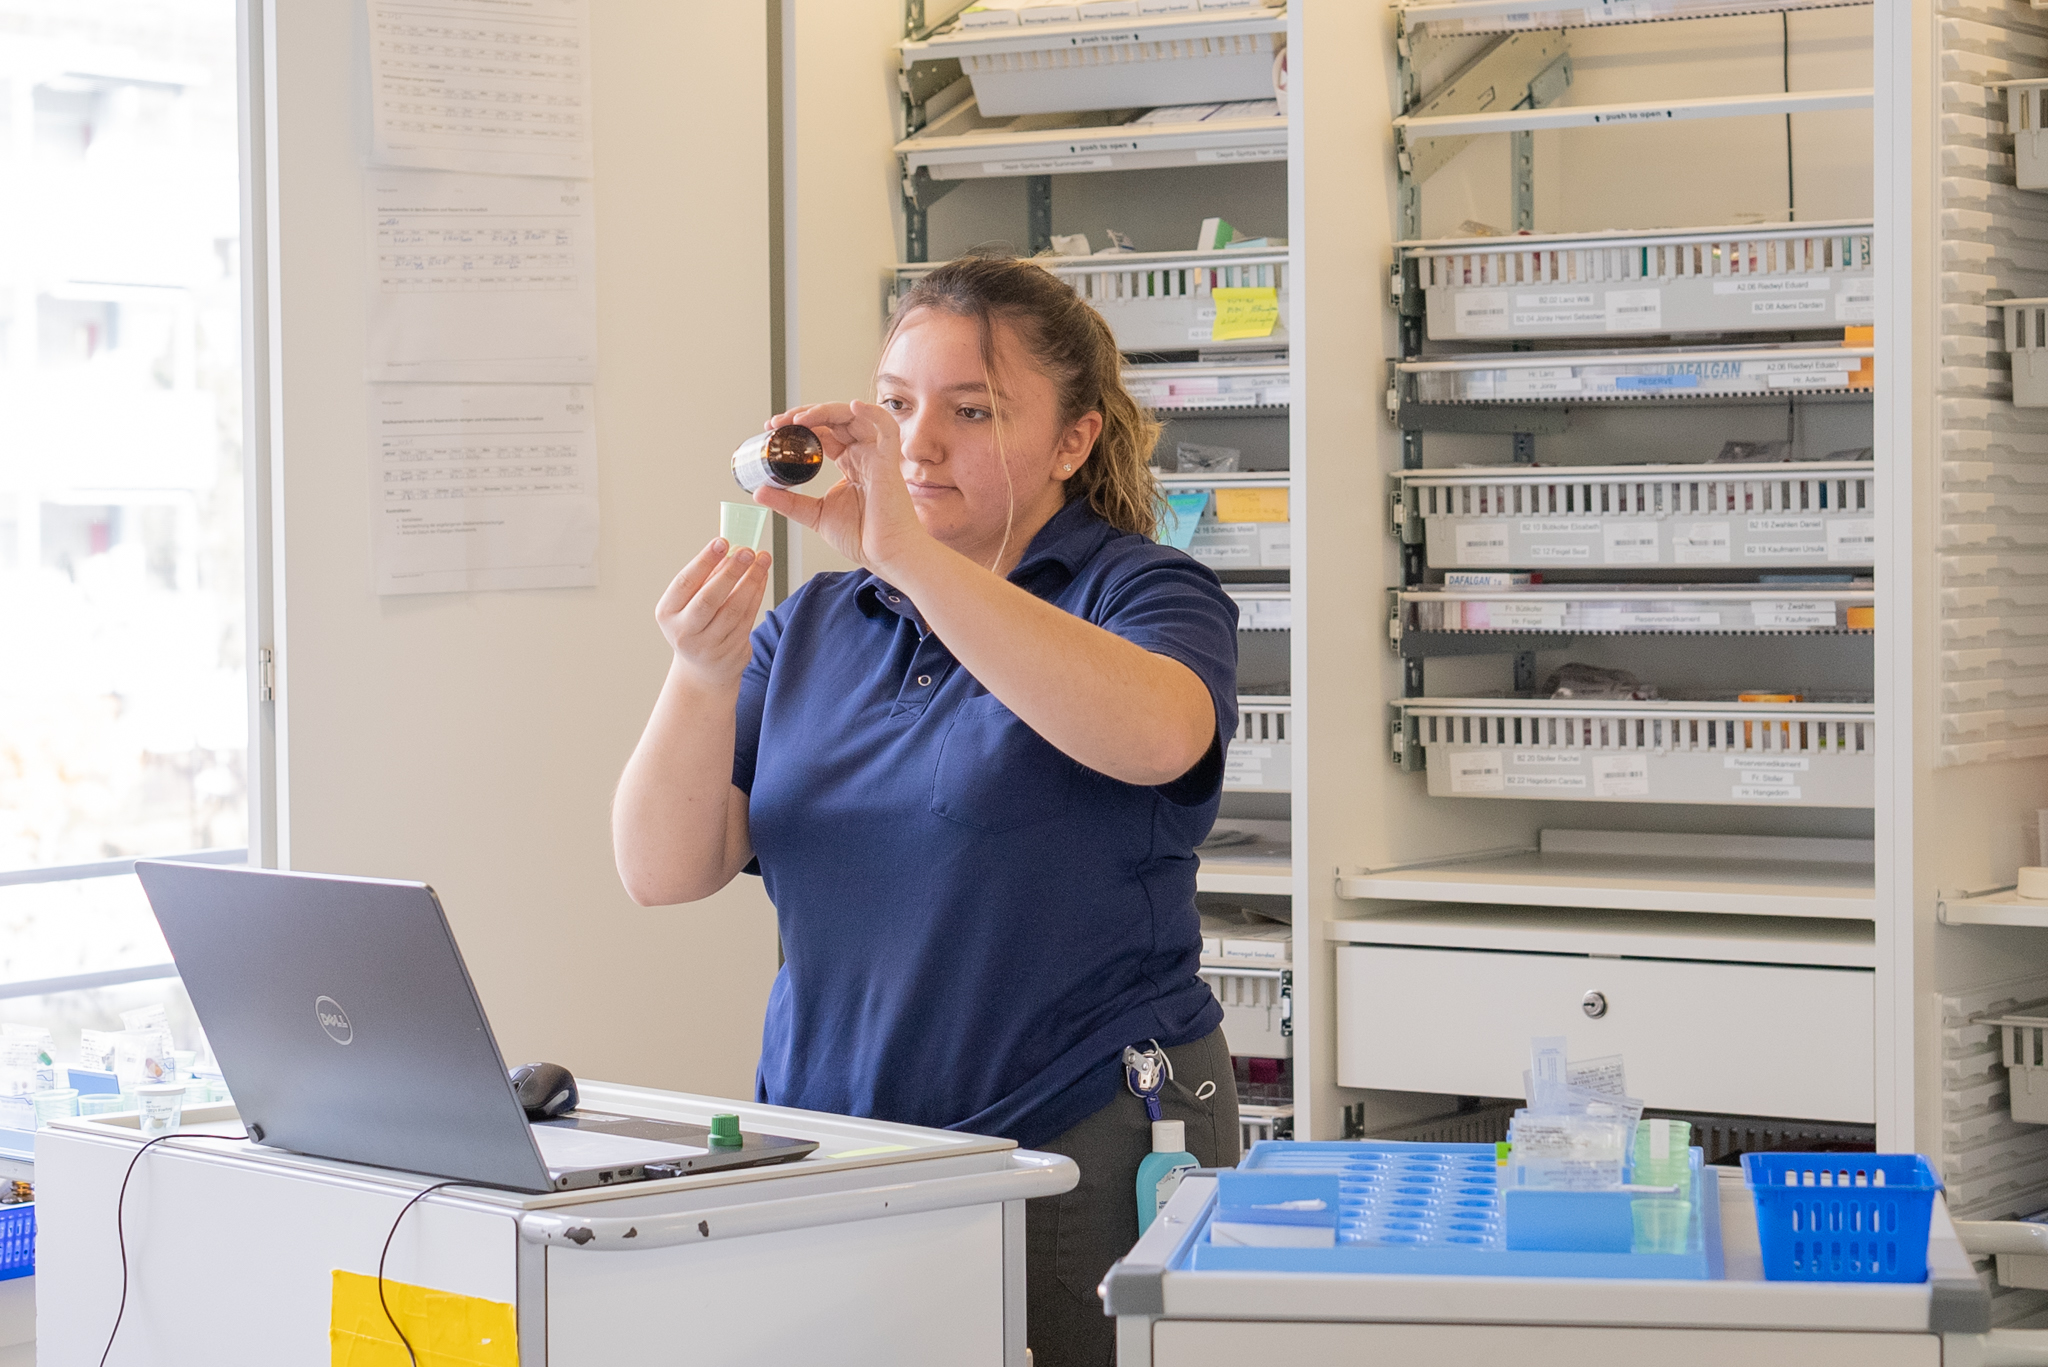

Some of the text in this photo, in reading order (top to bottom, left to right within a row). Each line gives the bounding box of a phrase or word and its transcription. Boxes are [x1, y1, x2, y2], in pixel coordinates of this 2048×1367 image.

[1785, 281, 1809, 289] Eduard
[1815, 361, 1839, 369] Eduard
[1667, 361, 1741, 379] DAFALGAN
[1800, 520, 1821, 528] Daniel
[1449, 576, 1490, 585] DAFALGAN
[1785, 615, 1819, 623] Kaufmann
[1226, 950, 1253, 958] Macrogol
[320, 1012, 348, 1028] DELL
